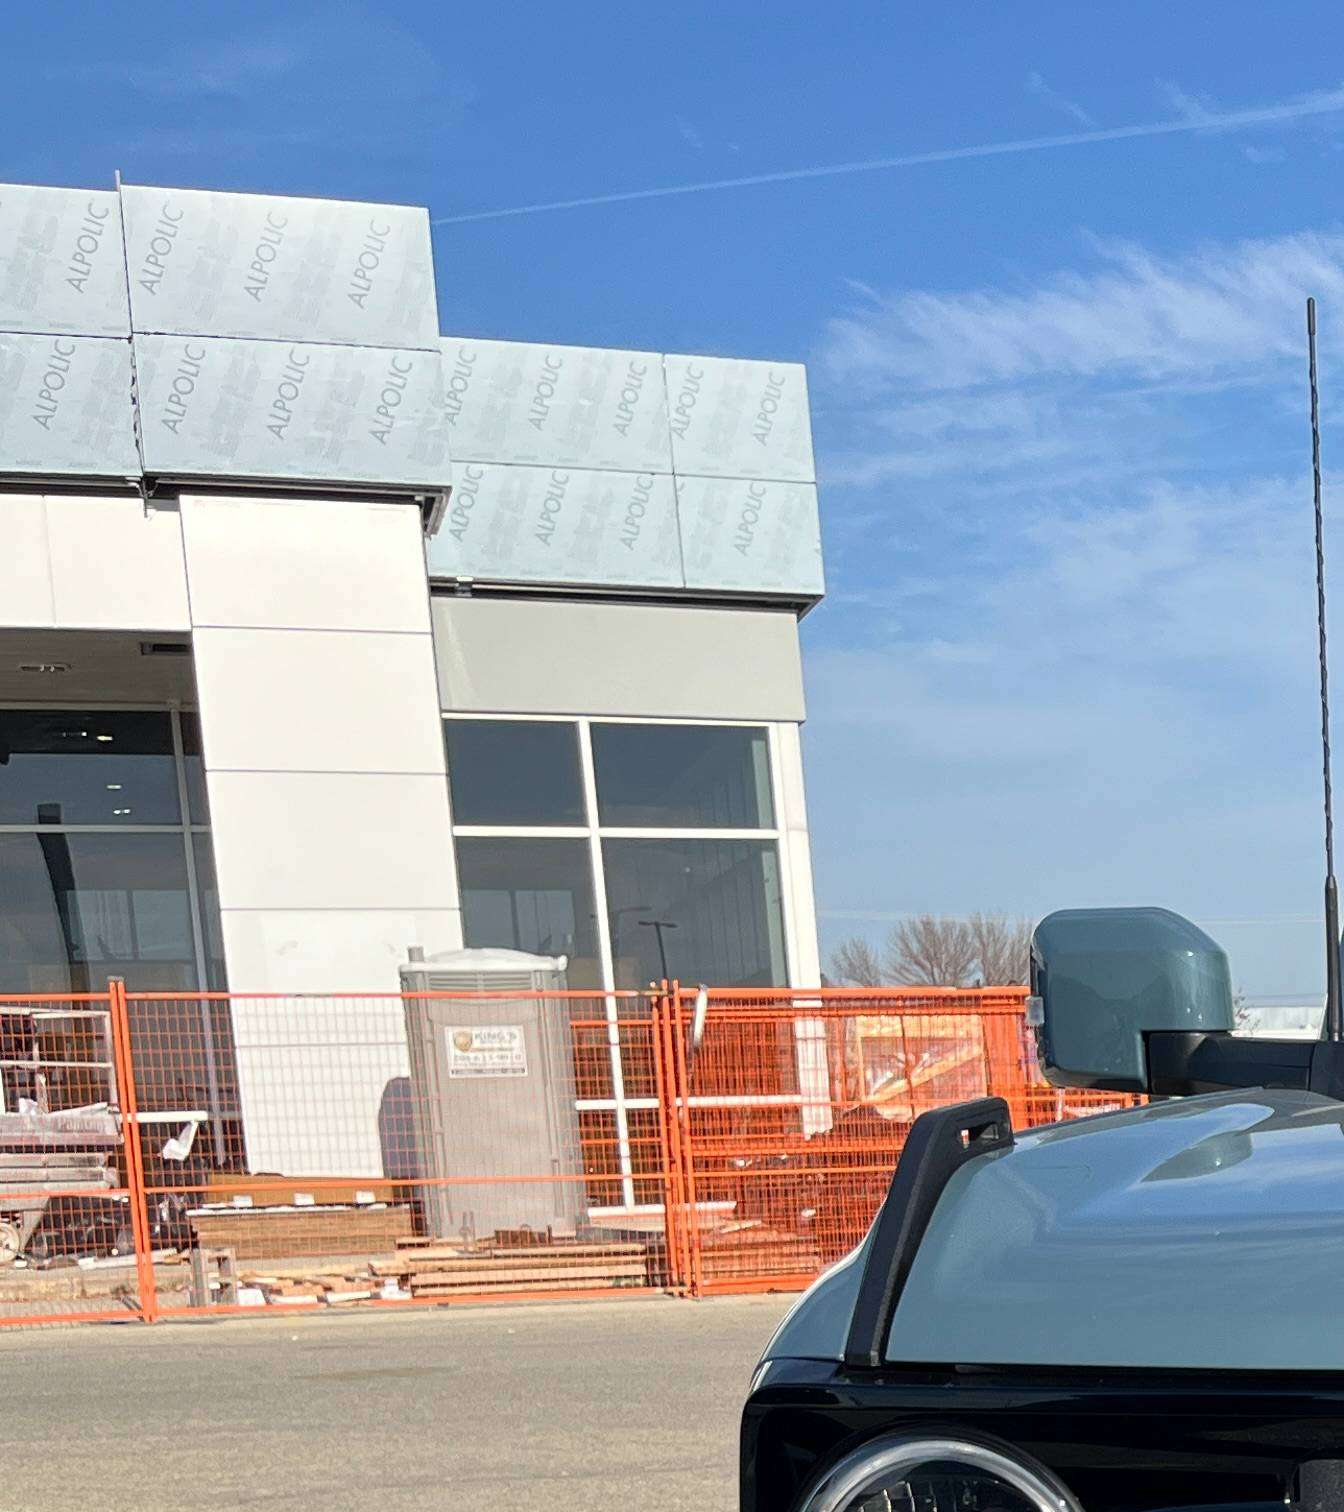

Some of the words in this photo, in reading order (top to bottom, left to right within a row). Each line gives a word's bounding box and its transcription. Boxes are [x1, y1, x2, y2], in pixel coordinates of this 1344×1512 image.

[66, 202, 109, 293] ALPOLIC
[138, 204, 183, 295] ALPOLIC
[244, 212, 287, 302] ALPOLIC
[347, 219, 390, 309] ALPOLIC
[33, 339, 75, 430] ALPOLIC
[162, 344, 205, 433] ALPOLIC
[267, 349, 309, 439] ALPOLIC
[369, 355, 413, 445] ALPOLIC
[445, 345, 476, 426] ALPOLIC
[529, 355, 562, 430] ALPOLIC
[613, 361, 647, 437] ALPOLIC
[671, 363, 704, 440] ALPOLIC
[753, 372, 785, 446] ALPOLIC
[450, 464, 483, 542] ALPOLIC
[535, 470, 569, 545] ALPOLIC
[620, 474, 653, 550] ALPOLIC
[734, 481, 766, 556] ALPOLIC
